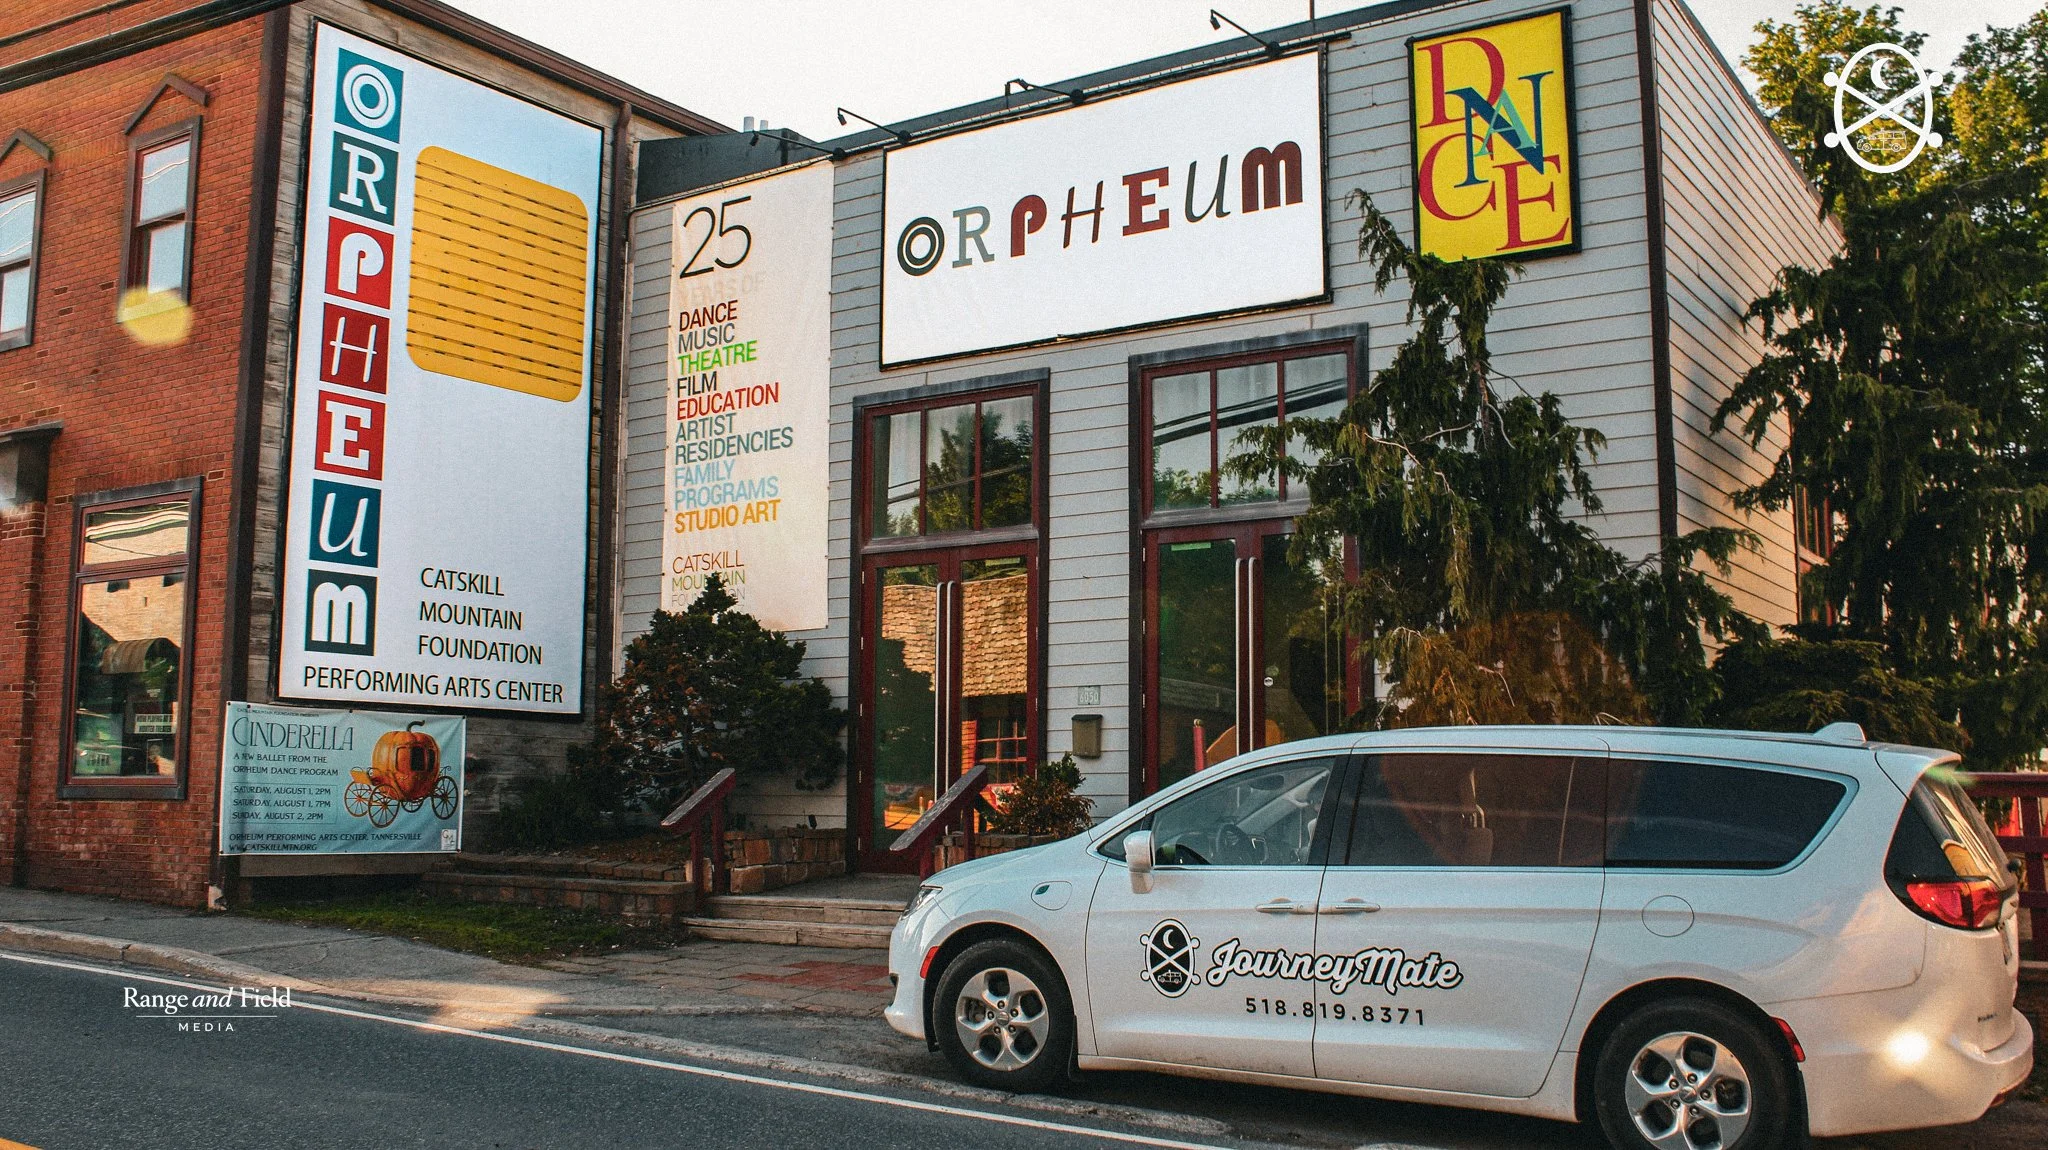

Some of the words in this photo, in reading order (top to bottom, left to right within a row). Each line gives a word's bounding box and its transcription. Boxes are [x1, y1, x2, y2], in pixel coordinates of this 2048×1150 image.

[679, 195, 752, 280] 25
[679, 299, 738, 332] DANCE
[678, 322, 735, 354] MUSIC
[677, 340, 758, 376] THEATRE
[677, 371, 718, 399] FILM
[677, 382, 779, 421] EDUCATION
[675, 412, 737, 444] ARTIST
[675, 426, 794, 466] RESIDENCIES
[674, 459, 736, 488] FAMILY
[674, 476, 780, 511] PROGRAMS
[674, 504, 739, 534] STUDIO
[742, 499, 781, 525] ART
[672, 549, 745, 574] CATSKILL
[421, 567, 505, 597] CATSKILL
[671, 569, 746, 592] MOUAIN
[419, 601, 523, 631] MOUNTAIN
[418, 634, 543, 665] FOUNDATION
[304, 666, 439, 696] PERFORMING
[444, 676, 491, 700] ARTS
[495, 679, 564, 704] CENTER
[232, 717, 354, 751] CINDERELLA
[257, 753, 286, 762] BALLET
[288, 754, 311, 763] FROM
[271, 767, 298, 775] DANCE
[300, 768, 339, 776] PROGRAM
[233, 785, 272, 794] SATURDAY,
[274, 787, 306, 795] AUGUST
[273, 799, 306, 807] AUGUST
[315, 800, 331, 808] 7PM
[264, 812, 295, 820] AUGUST
[229, 833, 264, 841] ORHEUM
[266, 833, 317, 841] PERFORMING
[319, 833, 338, 841] ARTS
[371, 833, 422, 841] TANNERSVILLE
[1206, 938, 1464, 996] JourneyMate
[1245, 998, 1424, 1026] 518.819.8371
